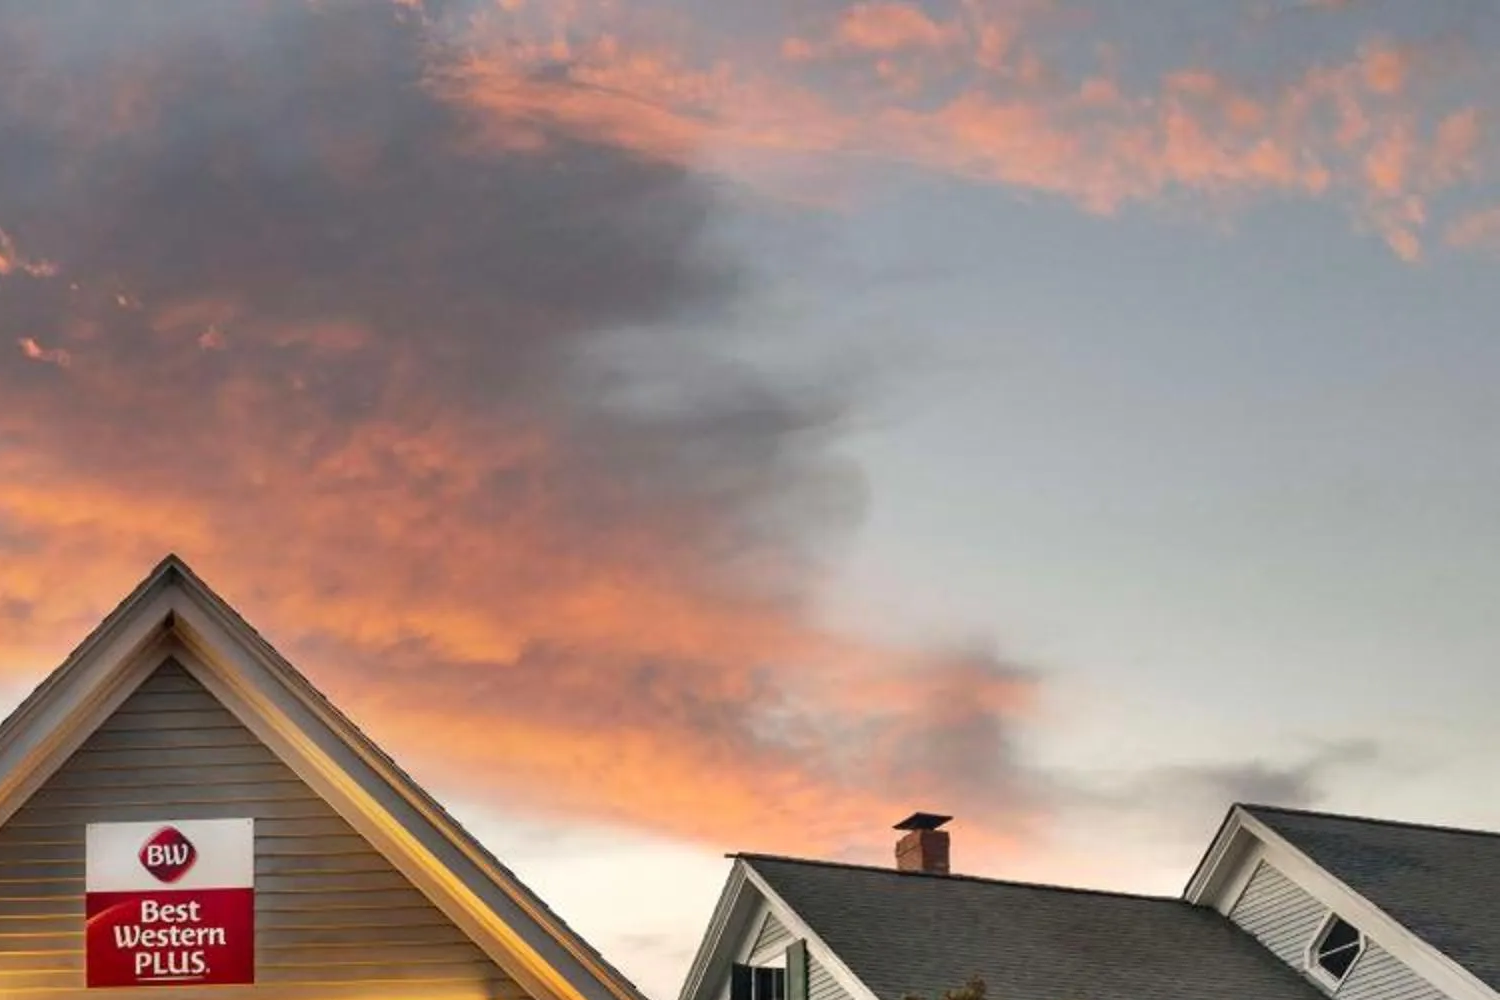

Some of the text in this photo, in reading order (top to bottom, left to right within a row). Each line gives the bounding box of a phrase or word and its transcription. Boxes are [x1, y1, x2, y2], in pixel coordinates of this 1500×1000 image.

[147, 843, 189, 866] BW
[141, 900, 201, 924] Best
[113, 925, 227, 949] Western
[135, 951, 205, 975] PLUS
